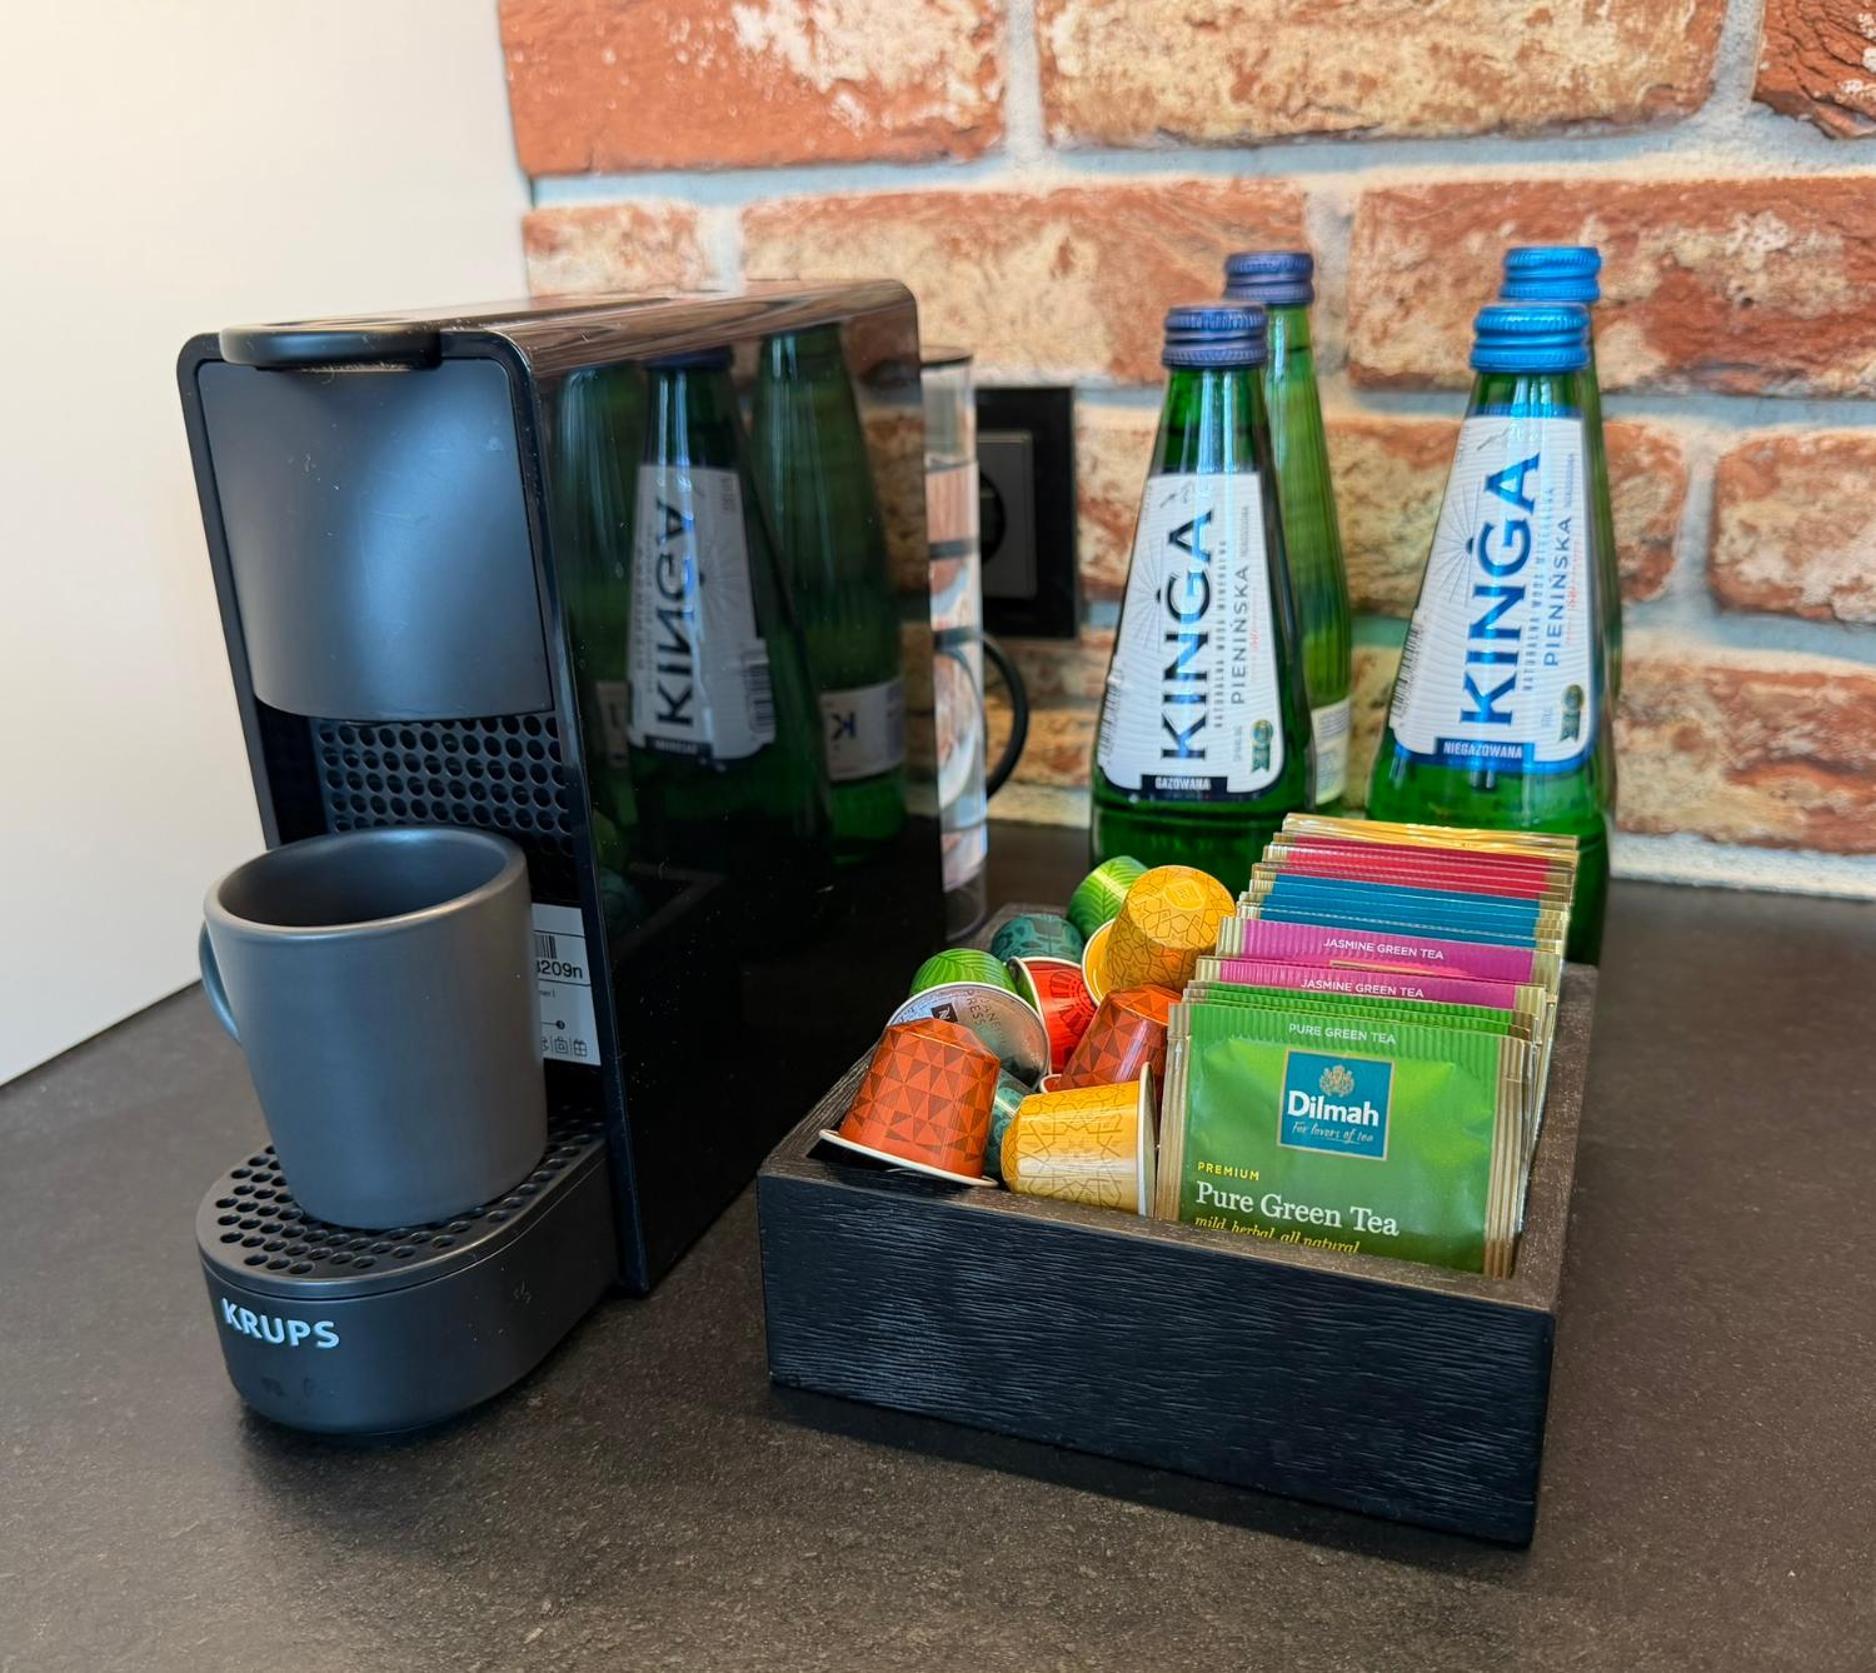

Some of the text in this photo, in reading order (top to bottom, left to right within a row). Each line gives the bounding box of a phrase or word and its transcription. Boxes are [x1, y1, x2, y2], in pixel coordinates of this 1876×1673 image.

[1460, 453, 1540, 725] KINGA
[1543, 517, 1572, 667] PIENIŃSKA
[1160, 509, 1213, 760] KINGA
[1231, 565, 1249, 705] PIENIŃSKA
[1443, 741, 1523, 759] NIEGAZOWANA
[1155, 776, 1211, 791] GAZOWANA
[1323, 938, 1444, 960] JASMINE GREEN TEA
[1301, 979, 1424, 998] JASMINE GREEN TEA
[1288, 1023, 1396, 1045] PURE GREEN TEA
[1287, 1090, 1380, 1127] Dilmah
[1292, 1121, 1374, 1144] For lovers of tea
[1198, 1161, 1260, 1181] PREMIUM
[1196, 1180, 1400, 1237] Pure Green Tea
[221, 1297, 340, 1348] KRUPS
